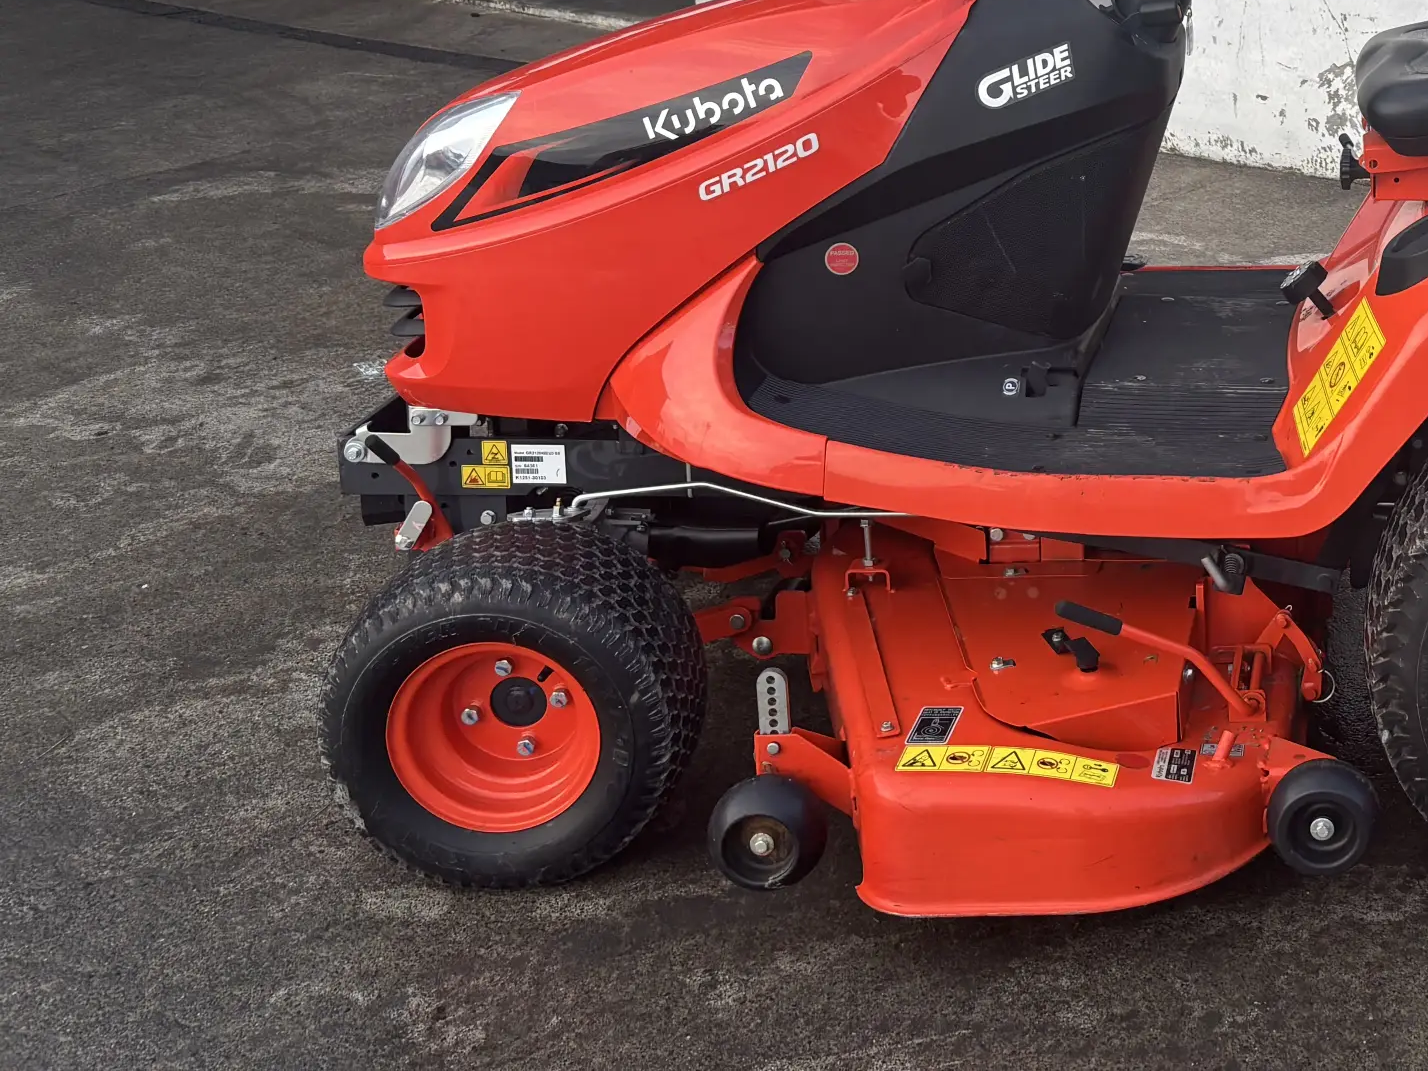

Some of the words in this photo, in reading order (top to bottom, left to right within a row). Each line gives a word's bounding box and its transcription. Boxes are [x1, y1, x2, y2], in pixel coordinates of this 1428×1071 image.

[977, 43, 1071, 108] GLIDE
[1015, 66, 1073, 99] STEER
[642, 77, 785, 141] Kubota
[698, 132, 820, 201] GR2120
